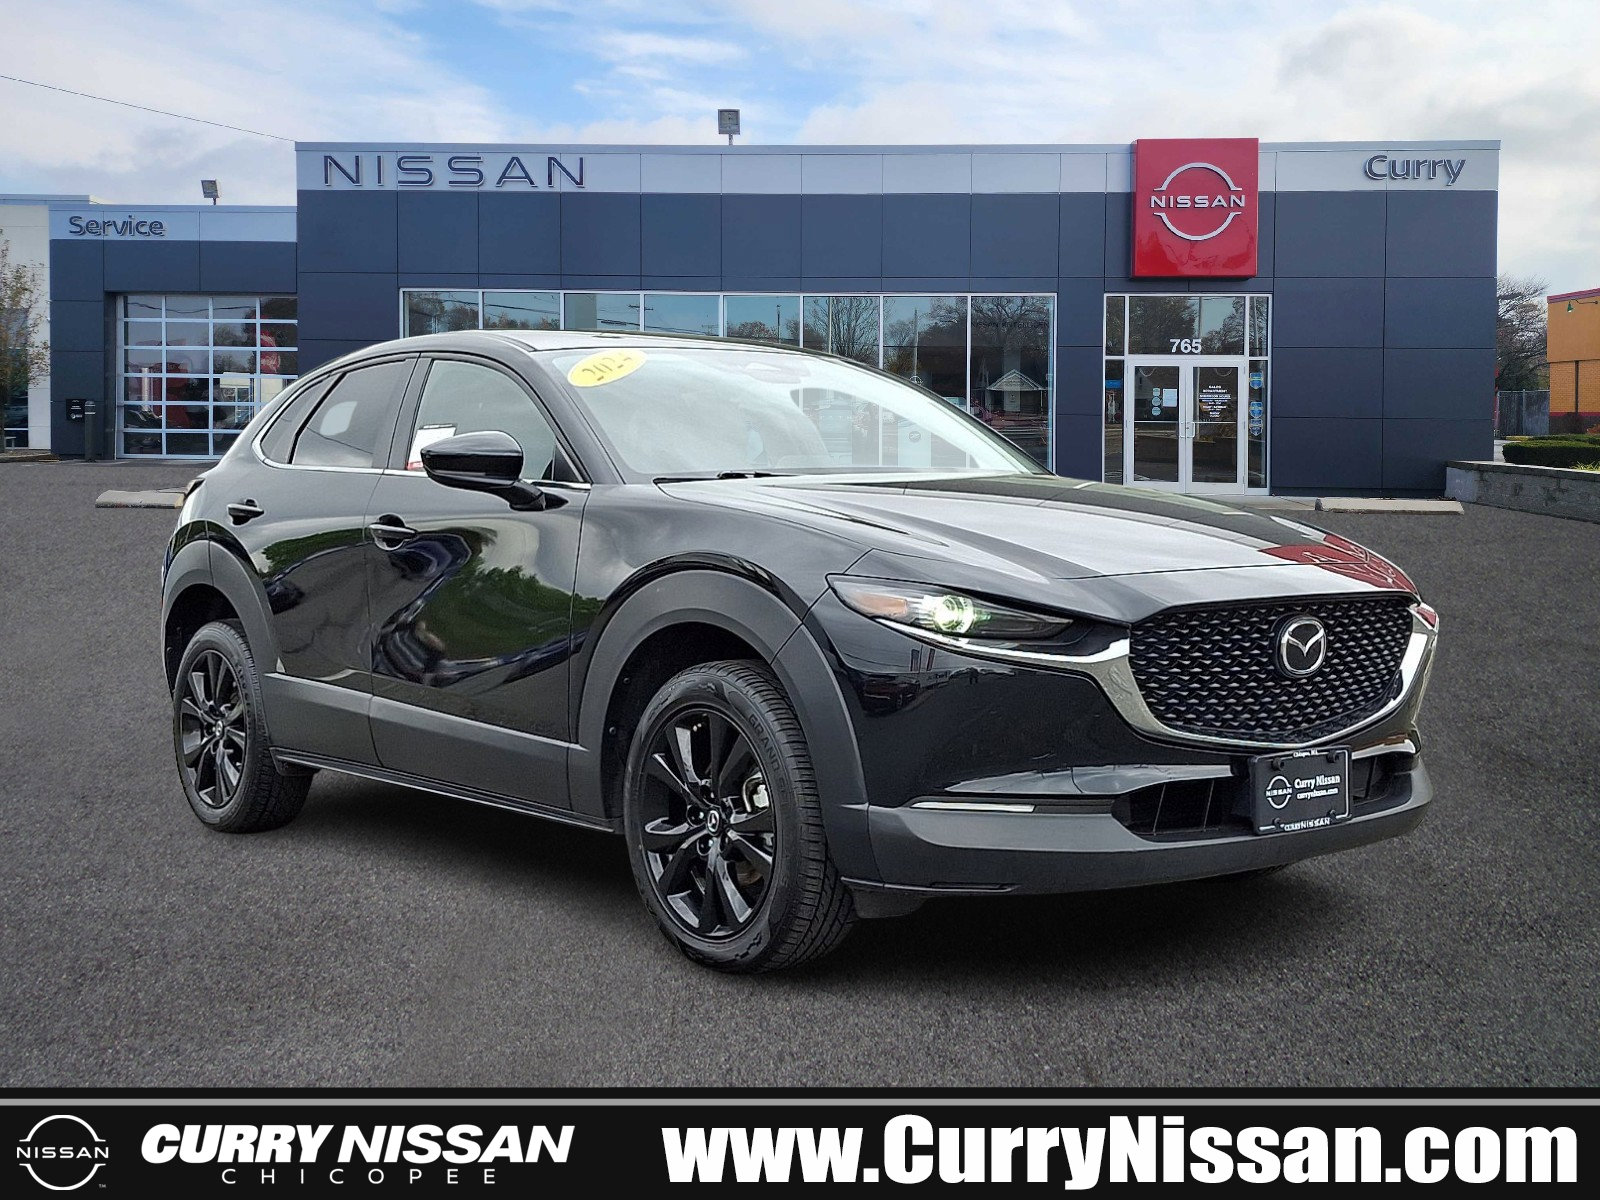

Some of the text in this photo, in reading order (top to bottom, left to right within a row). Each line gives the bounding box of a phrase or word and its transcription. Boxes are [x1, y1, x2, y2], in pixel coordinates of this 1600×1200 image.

[323, 155, 585, 188] NISSAN
[1365, 154, 1466, 187] Curry
[1150, 194, 1246, 208] NISSAN
[68, 214, 166, 236] Service
[1169, 338, 1202, 354] 765
[1294, 774, 1341, 790] Curry Nissan
[1265, 788, 1293, 797] NISSAN
